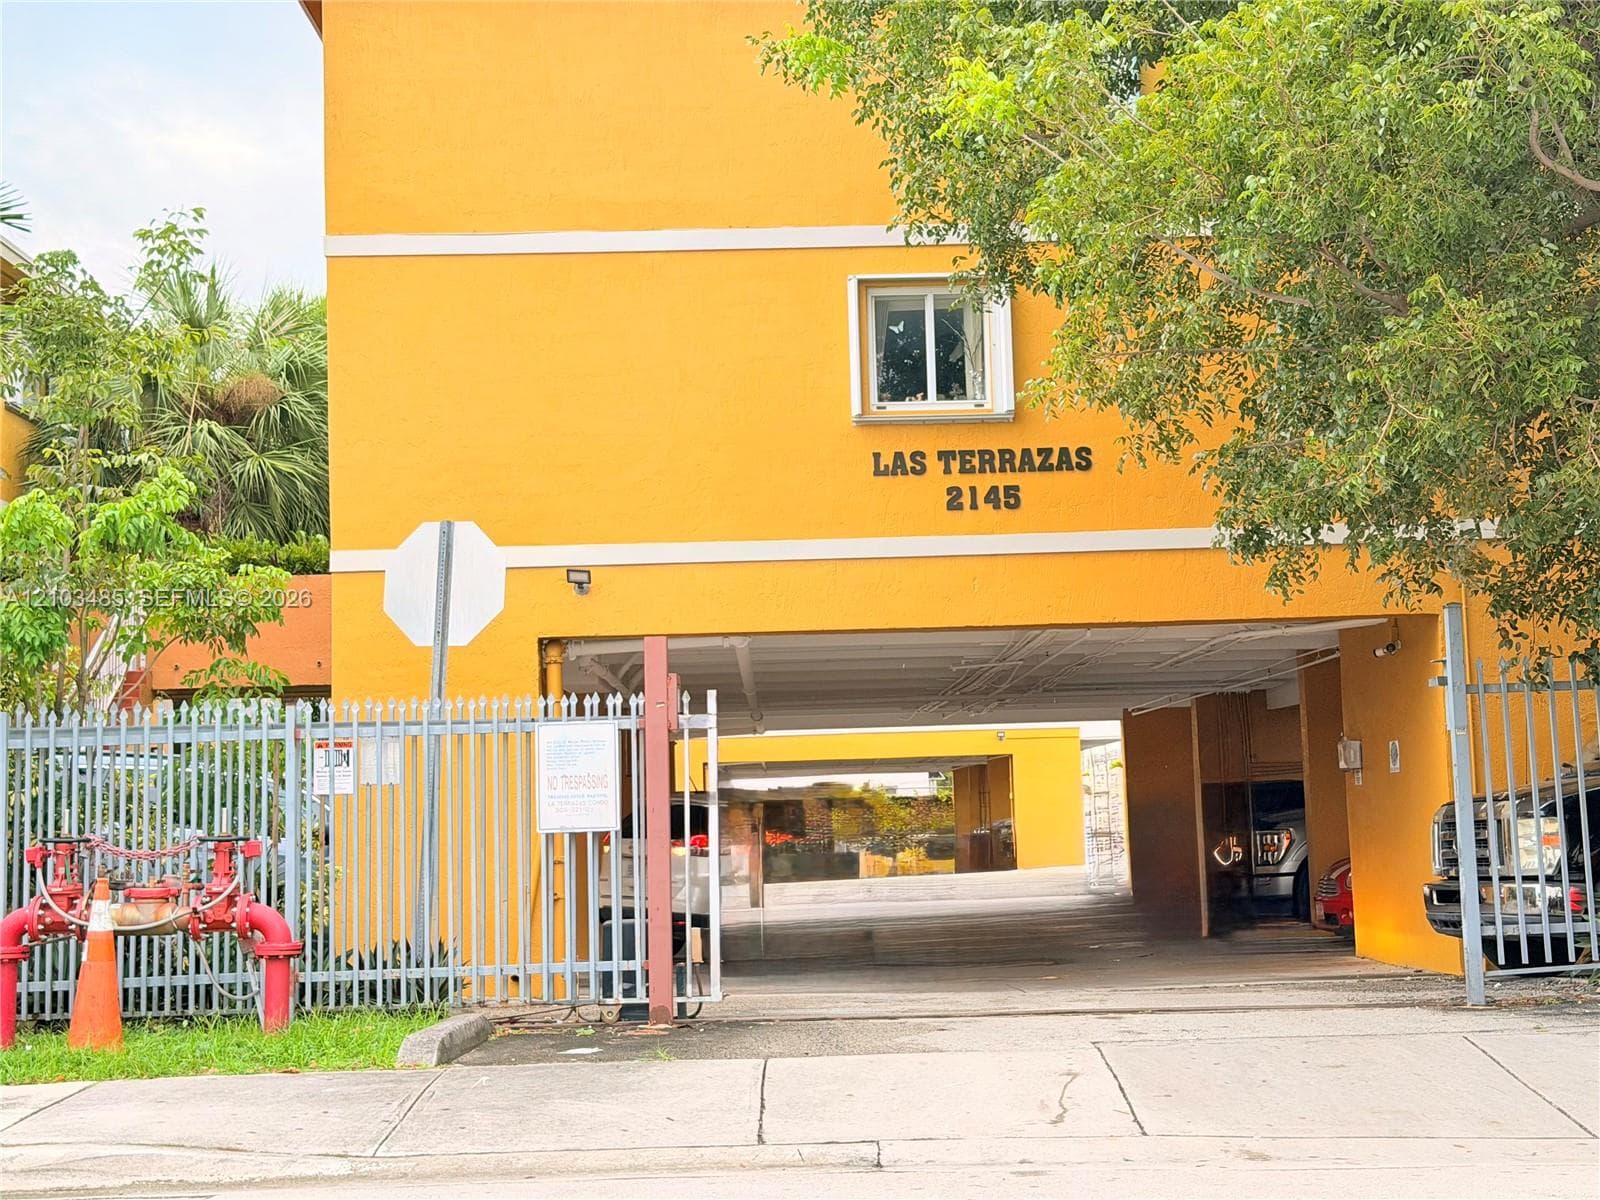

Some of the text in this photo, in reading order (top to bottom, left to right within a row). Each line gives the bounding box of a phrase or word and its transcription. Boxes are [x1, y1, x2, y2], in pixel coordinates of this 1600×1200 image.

[872, 447, 1093, 476] LAS TERRAZAS
[946, 485, 1021, 511] 2145
[547, 774, 608, 791] NO TRESPASSING
